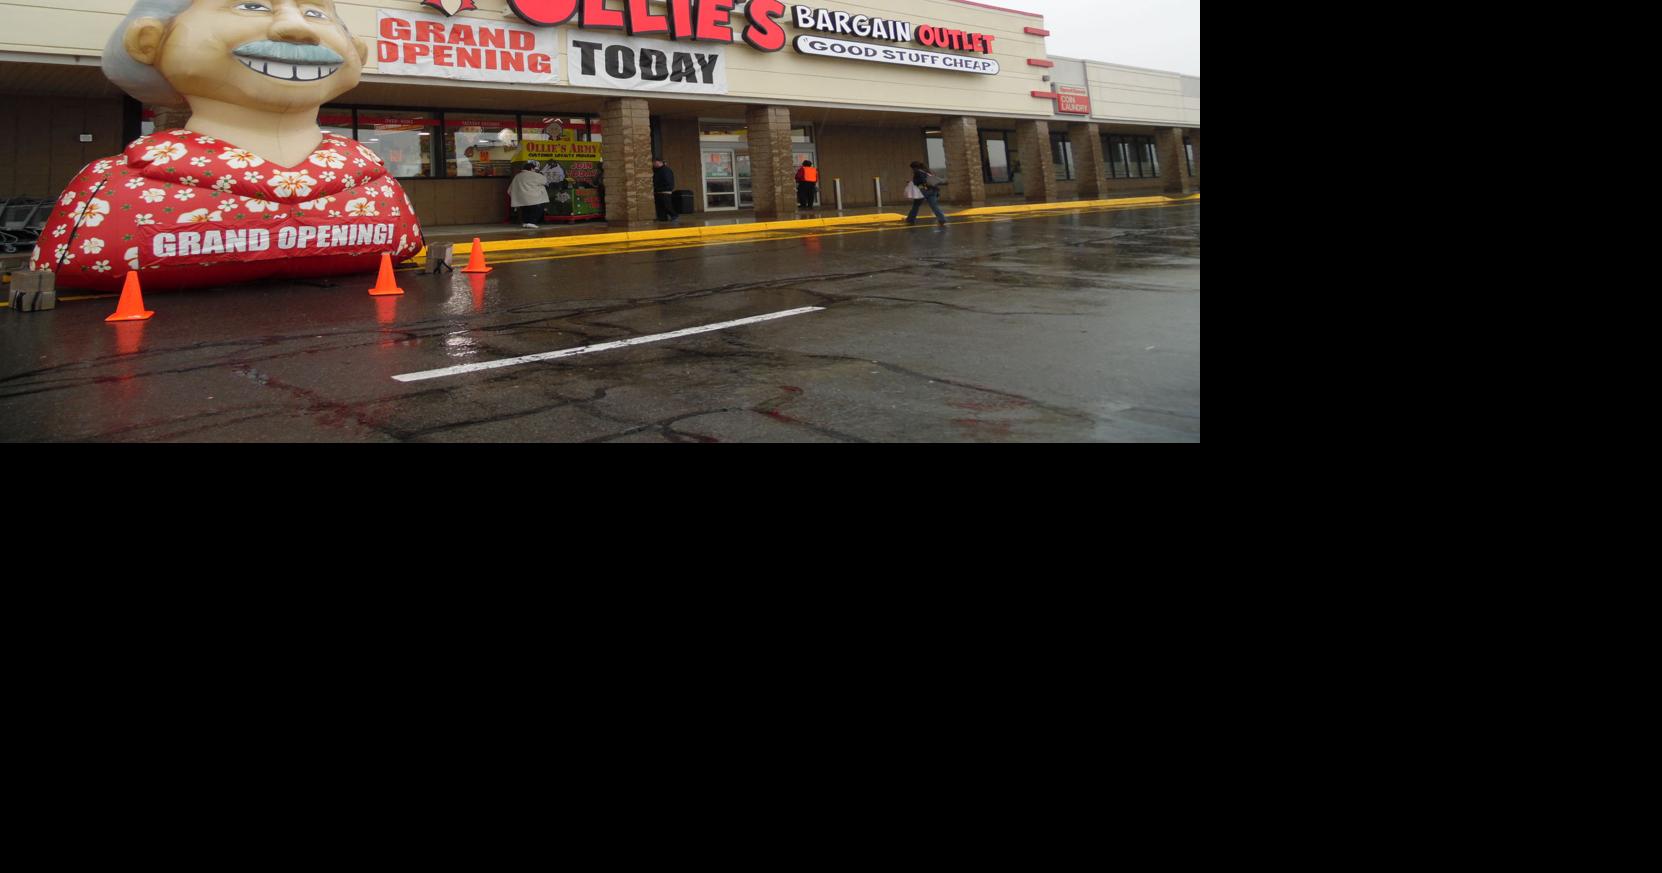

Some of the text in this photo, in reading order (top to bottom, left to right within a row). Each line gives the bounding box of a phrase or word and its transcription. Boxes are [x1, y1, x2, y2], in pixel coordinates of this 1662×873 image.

[379, 17, 536, 52] GRAND
[793, 5, 996, 54] BARGAIN OUTLET
[376, 40, 552, 74] OPENING
[572, 40, 719, 84] TODAY
[883, 49, 940, 65] STUFF
[526, 142, 597, 154] OLLIE'S ARMY
[152, 223, 395, 257] GRAND OPENING!
